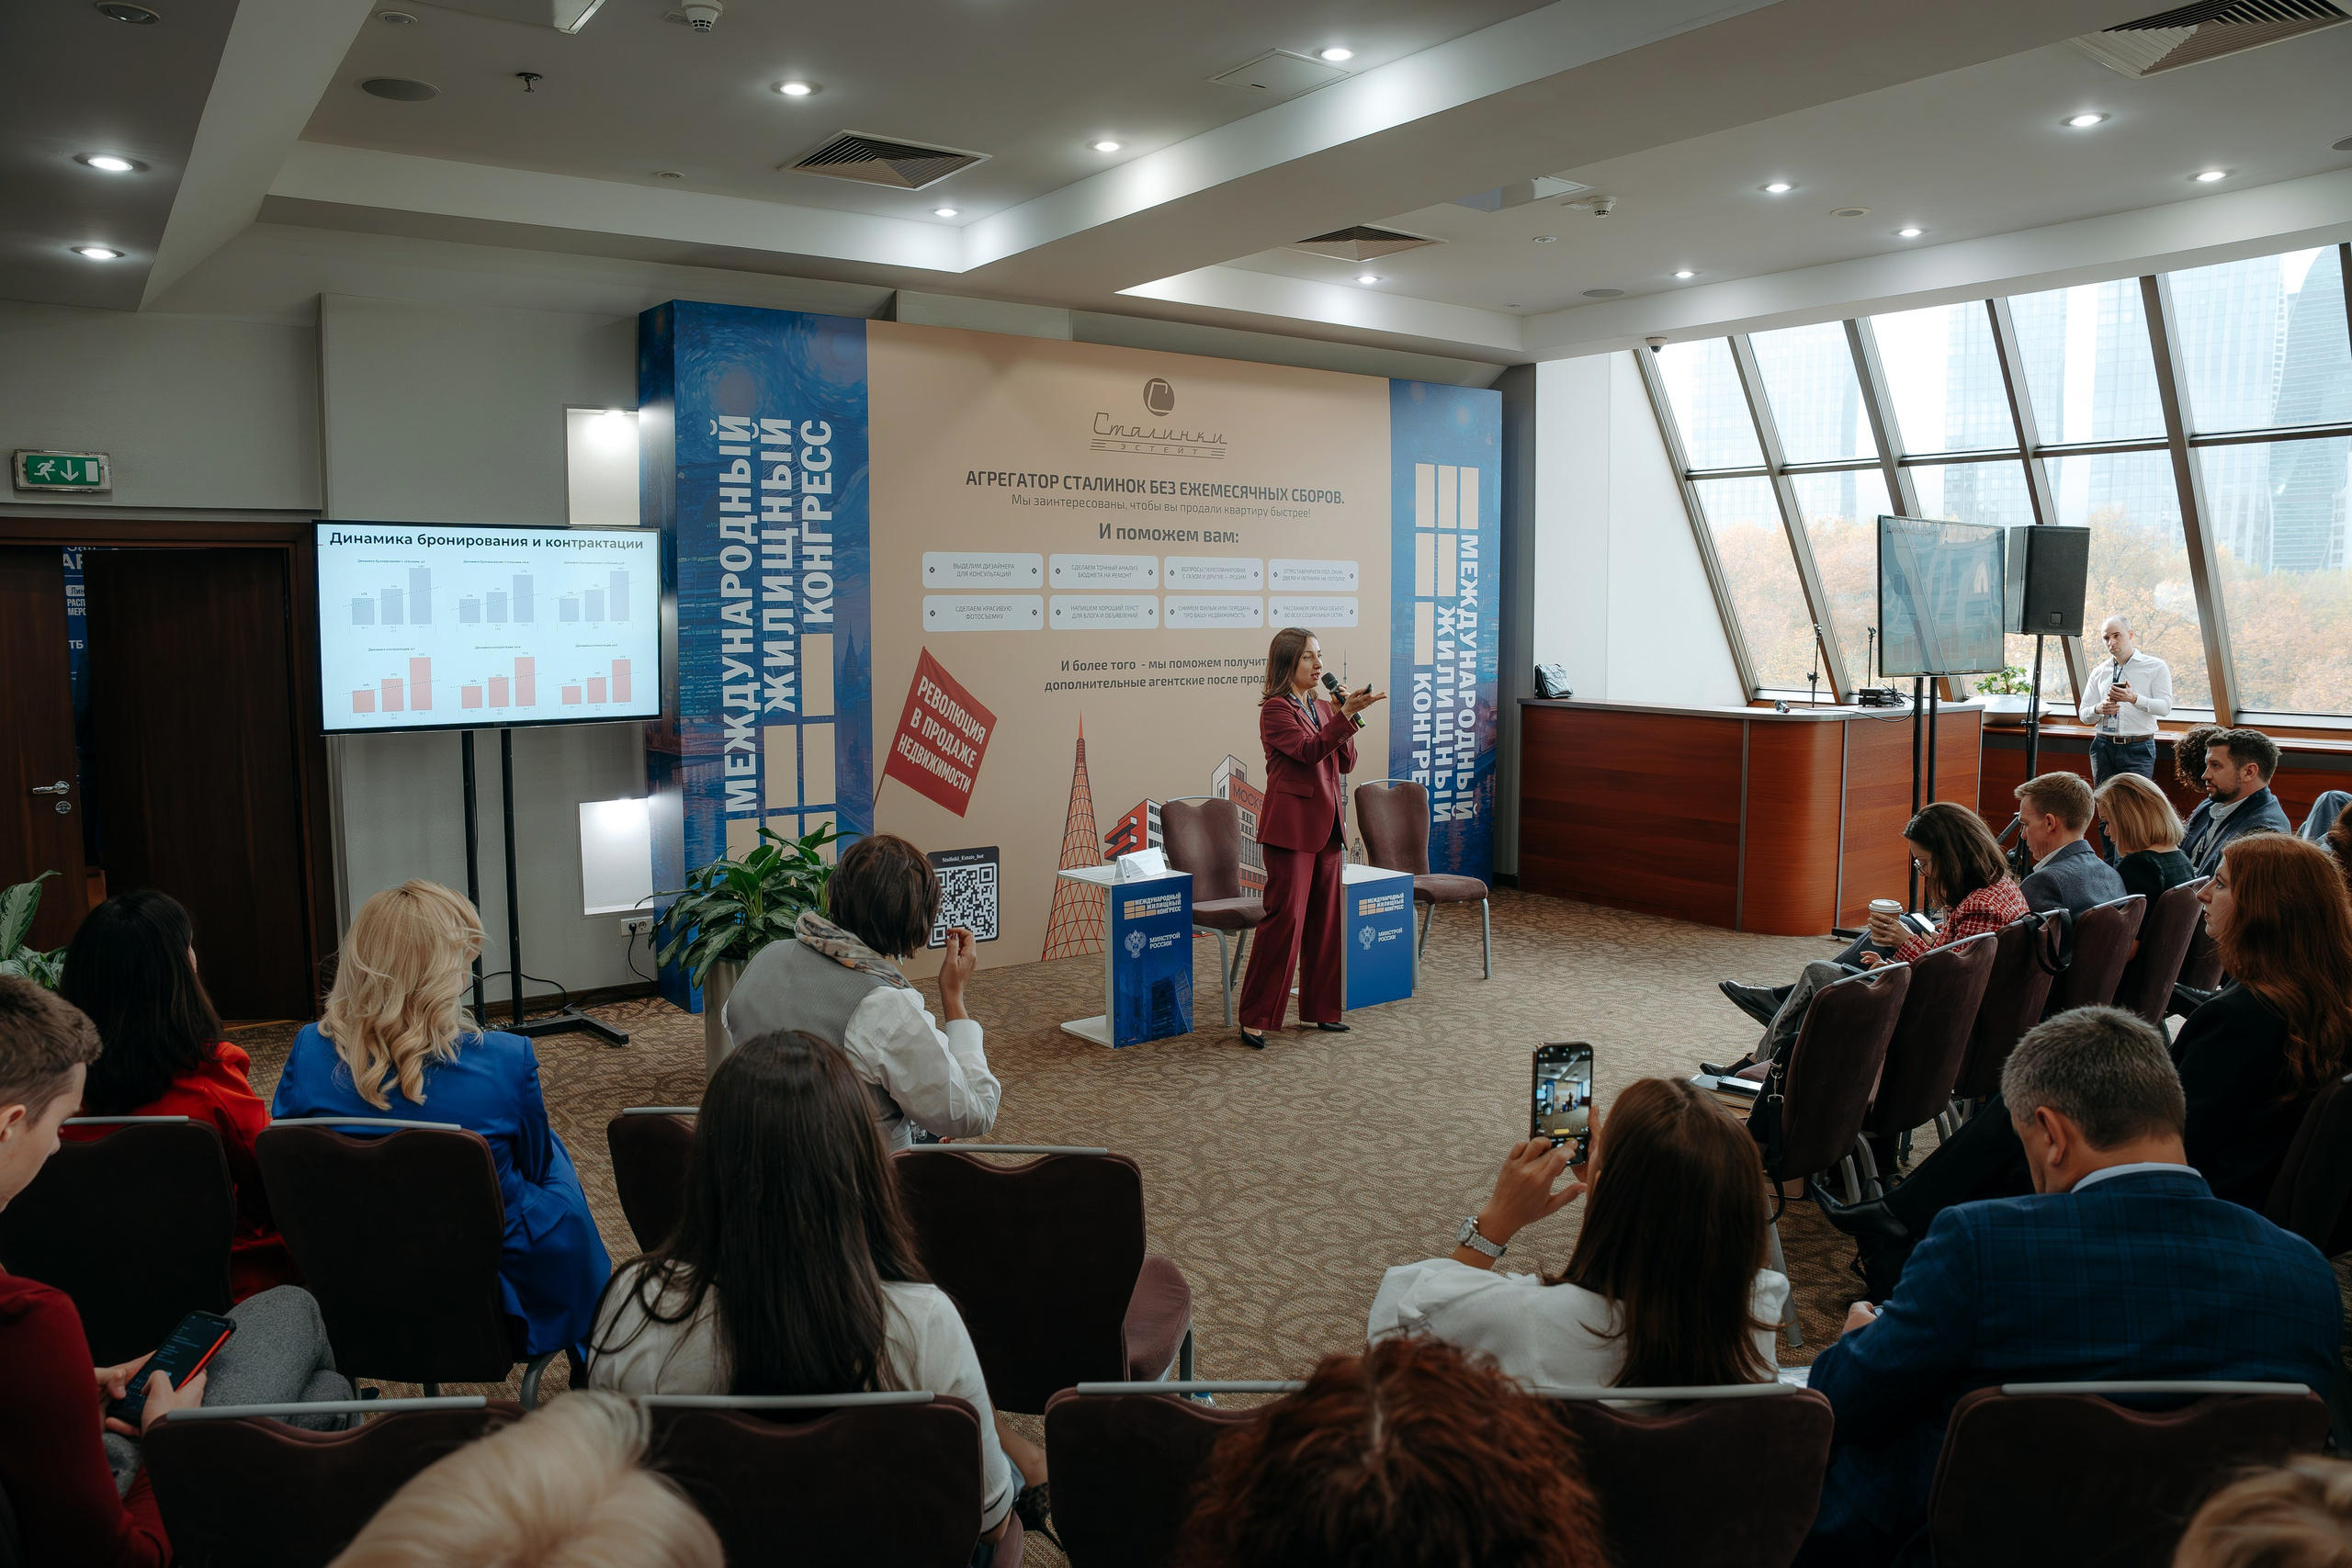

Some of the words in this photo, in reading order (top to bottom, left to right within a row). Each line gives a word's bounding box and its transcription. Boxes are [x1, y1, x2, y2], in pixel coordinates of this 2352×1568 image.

[1093, 412, 1227, 445] Сталинки
[1120, 444, 1198, 455] ЭСТЕЙТ
[966, 470, 1059, 490] АГРЕГАТОР
[1063, 475, 1147, 494] СТАЛИНОК
[1150, 479, 1176, 495] БЕЗ
[1180, 481, 1288, 502] ЕЖЕМЕСЯЧНЫХ
[1292, 489, 1345, 504] СБОРОВ.
[1012, 494, 1031, 506] Мы
[1034, 497, 1127, 511] заинтересованы,
[1130, 501, 1161, 511] чтобы
[1181, 503, 1222, 514] продали
[1225, 506, 1268, 517] квартиру
[1271, 506, 1311, 518] быстрее!
[800, 420, 834, 624] КОНГРЕСС
[1099, 523, 1111, 539] И
[1116, 527, 1199, 543] поможем
[1204, 530, 1239, 544] вам:
[330, 532, 413, 546] Динамика
[417, 534, 528, 548] бронирования
[533, 538, 541, 547] и
[546, 538, 643, 550] контрактации
[751, 418, 798, 714] ЖИЛИЩНЫЙ
[710, 414, 761, 812] МЕЖДУНАРОДНЫЙ
[1061, 660, 1069, 671] И
[1072, 660, 1108, 671] более
[1111, 661, 1136, 671] того
[1148, 660, 1167, 669] мы
[1169, 659, 1221, 669] поможем
[1453, 534, 1478, 820] МЕЖДУНАРОДНЫЙ
[1045, 678, 1147, 693] дополнительные
[1148, 676, 1205, 687] агентские
[1207, 676, 1238, 685] после
[1241, 675, 1265, 686] прод
[917, 675, 986, 745] РЕВОЛЮЦИЯ
[1431, 605, 1456, 823] ЖИЛИЩНЫЙ
[910, 707, 922, 729] В
[921, 716, 977, 768] ПРОДАЖЕ
[1411, 672, 1432, 786] КОНГРЕ
[897, 733, 971, 793] НЕДВИЖИМОСТИ
[1135, 892, 1181, 905] МЕЖДУНАРОДНЫЙ
[1147, 900, 1181, 910] ЖИЛИЩНЫЙ
[1157, 906, 1181, 915] КОНГРЕСС
[1150, 932, 1180, 943] МИНСТРОЙ
[1150, 941, 1172, 949] РОССИИ
